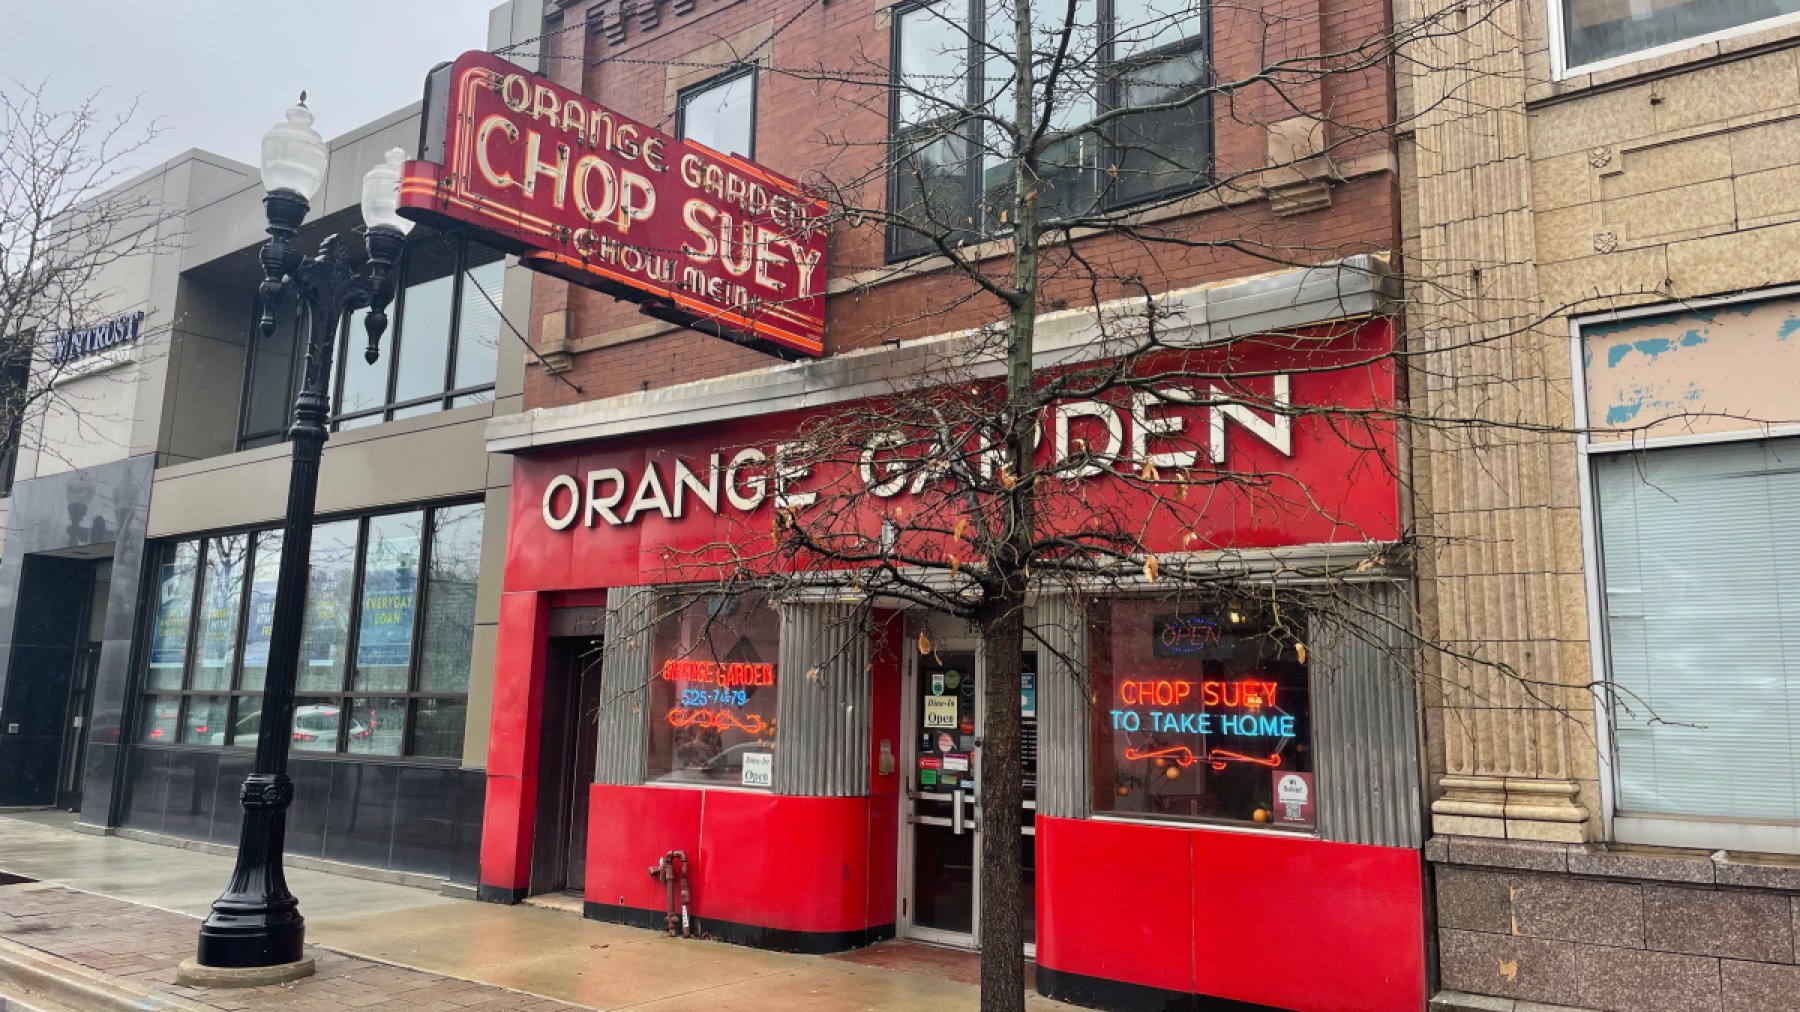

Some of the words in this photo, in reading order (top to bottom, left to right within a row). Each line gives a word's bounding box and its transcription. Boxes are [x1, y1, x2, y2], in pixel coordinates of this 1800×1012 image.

[502, 72, 668, 172] ORANGE
[681, 153, 808, 231] GARDEN
[476, 115, 656, 233] CHOP
[681, 198, 822, 300] SUEY
[573, 227, 678, 283] CHOW
[683, 266, 748, 315] MEIN
[542, 442, 817, 530] ORANGE
[365, 594, 412, 610] EVERYDAY
[1161, 625, 1221, 647] OPEN
[716, 662, 775, 687] GARDEN
[682, 689, 747, 706] 525-7479
[1120, 680, 1191, 706] CHOP
[1202, 681, 1278, 707] SUEY
[928, 712, 954, 725] Open
[1110, 710, 1140, 731] TO
[1150, 711, 1213, 734] TAKE
[1221, 714, 1296, 736] HOME
